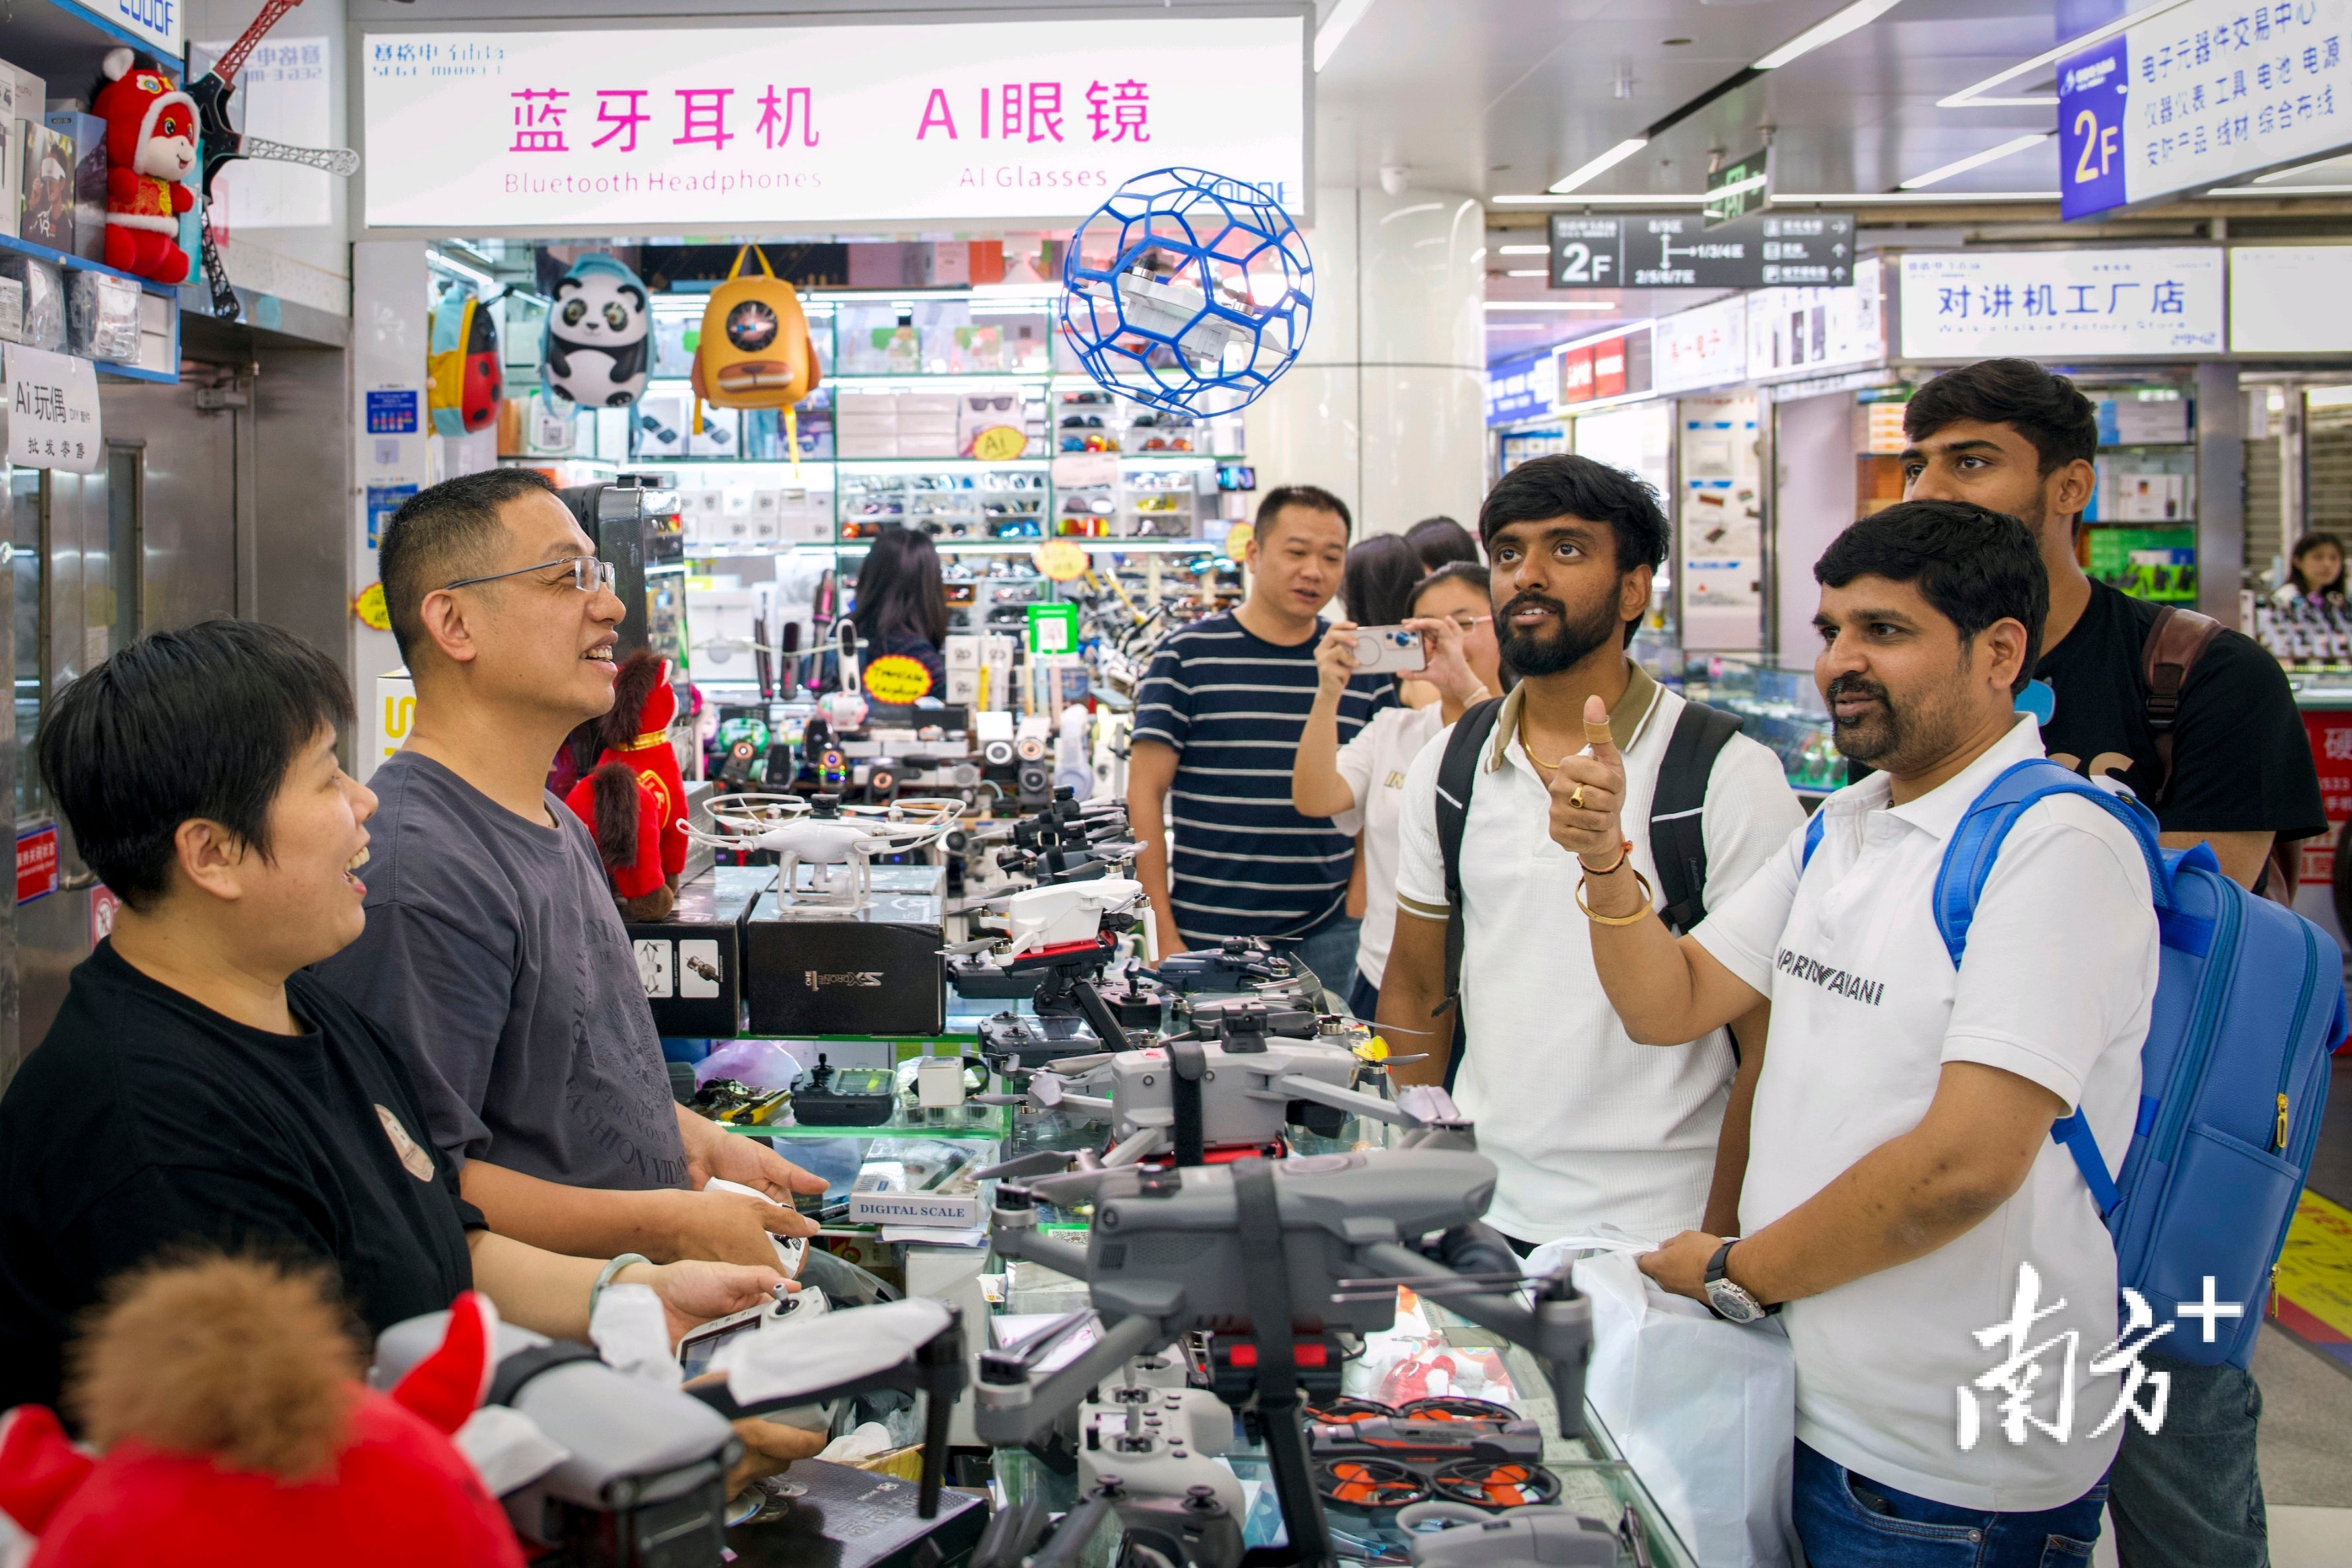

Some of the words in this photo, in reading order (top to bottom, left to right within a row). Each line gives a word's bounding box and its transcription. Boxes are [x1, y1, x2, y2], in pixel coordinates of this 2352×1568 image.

[2214, 69, 2248, 105] 工具
[509, 84, 820, 153] 蓝牙耳机
[2074, 109, 2119, 184] 2F
[505, 172, 639, 194] Bluetooth
[648, 169, 822, 195] Headphones
[960, 167, 985, 188] AI
[996, 165, 1108, 188] Glasses
[1561, 242, 1613, 283] 2F
[1938, 279, 2185, 319] 对讲机工厂店
[34, 385, 67, 423] 玩偶
[28, 437, 85, 460] 批发零售
[860, 1204, 917, 1215] DIGITAL
[920, 1207, 965, 1217] SCALE
